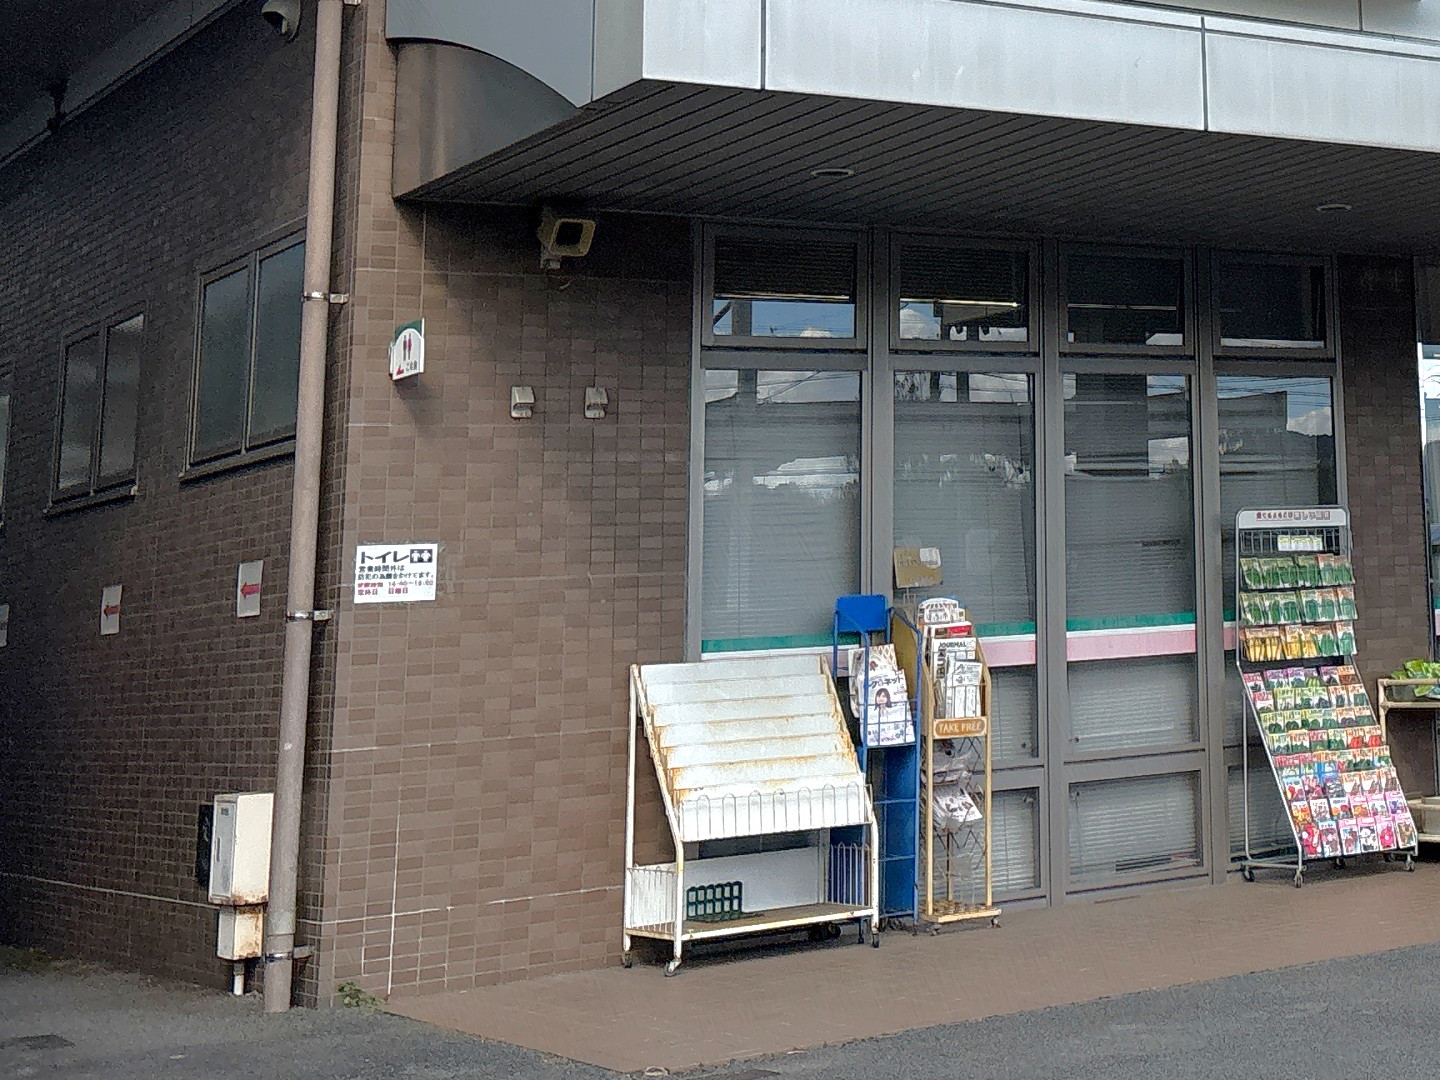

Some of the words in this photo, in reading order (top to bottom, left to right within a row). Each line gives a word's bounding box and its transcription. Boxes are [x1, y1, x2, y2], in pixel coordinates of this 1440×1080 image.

[361, 550, 409, 564] トイレ
[938, 723, 960, 734] TAKE
[961, 720, 982, 732] FREE
